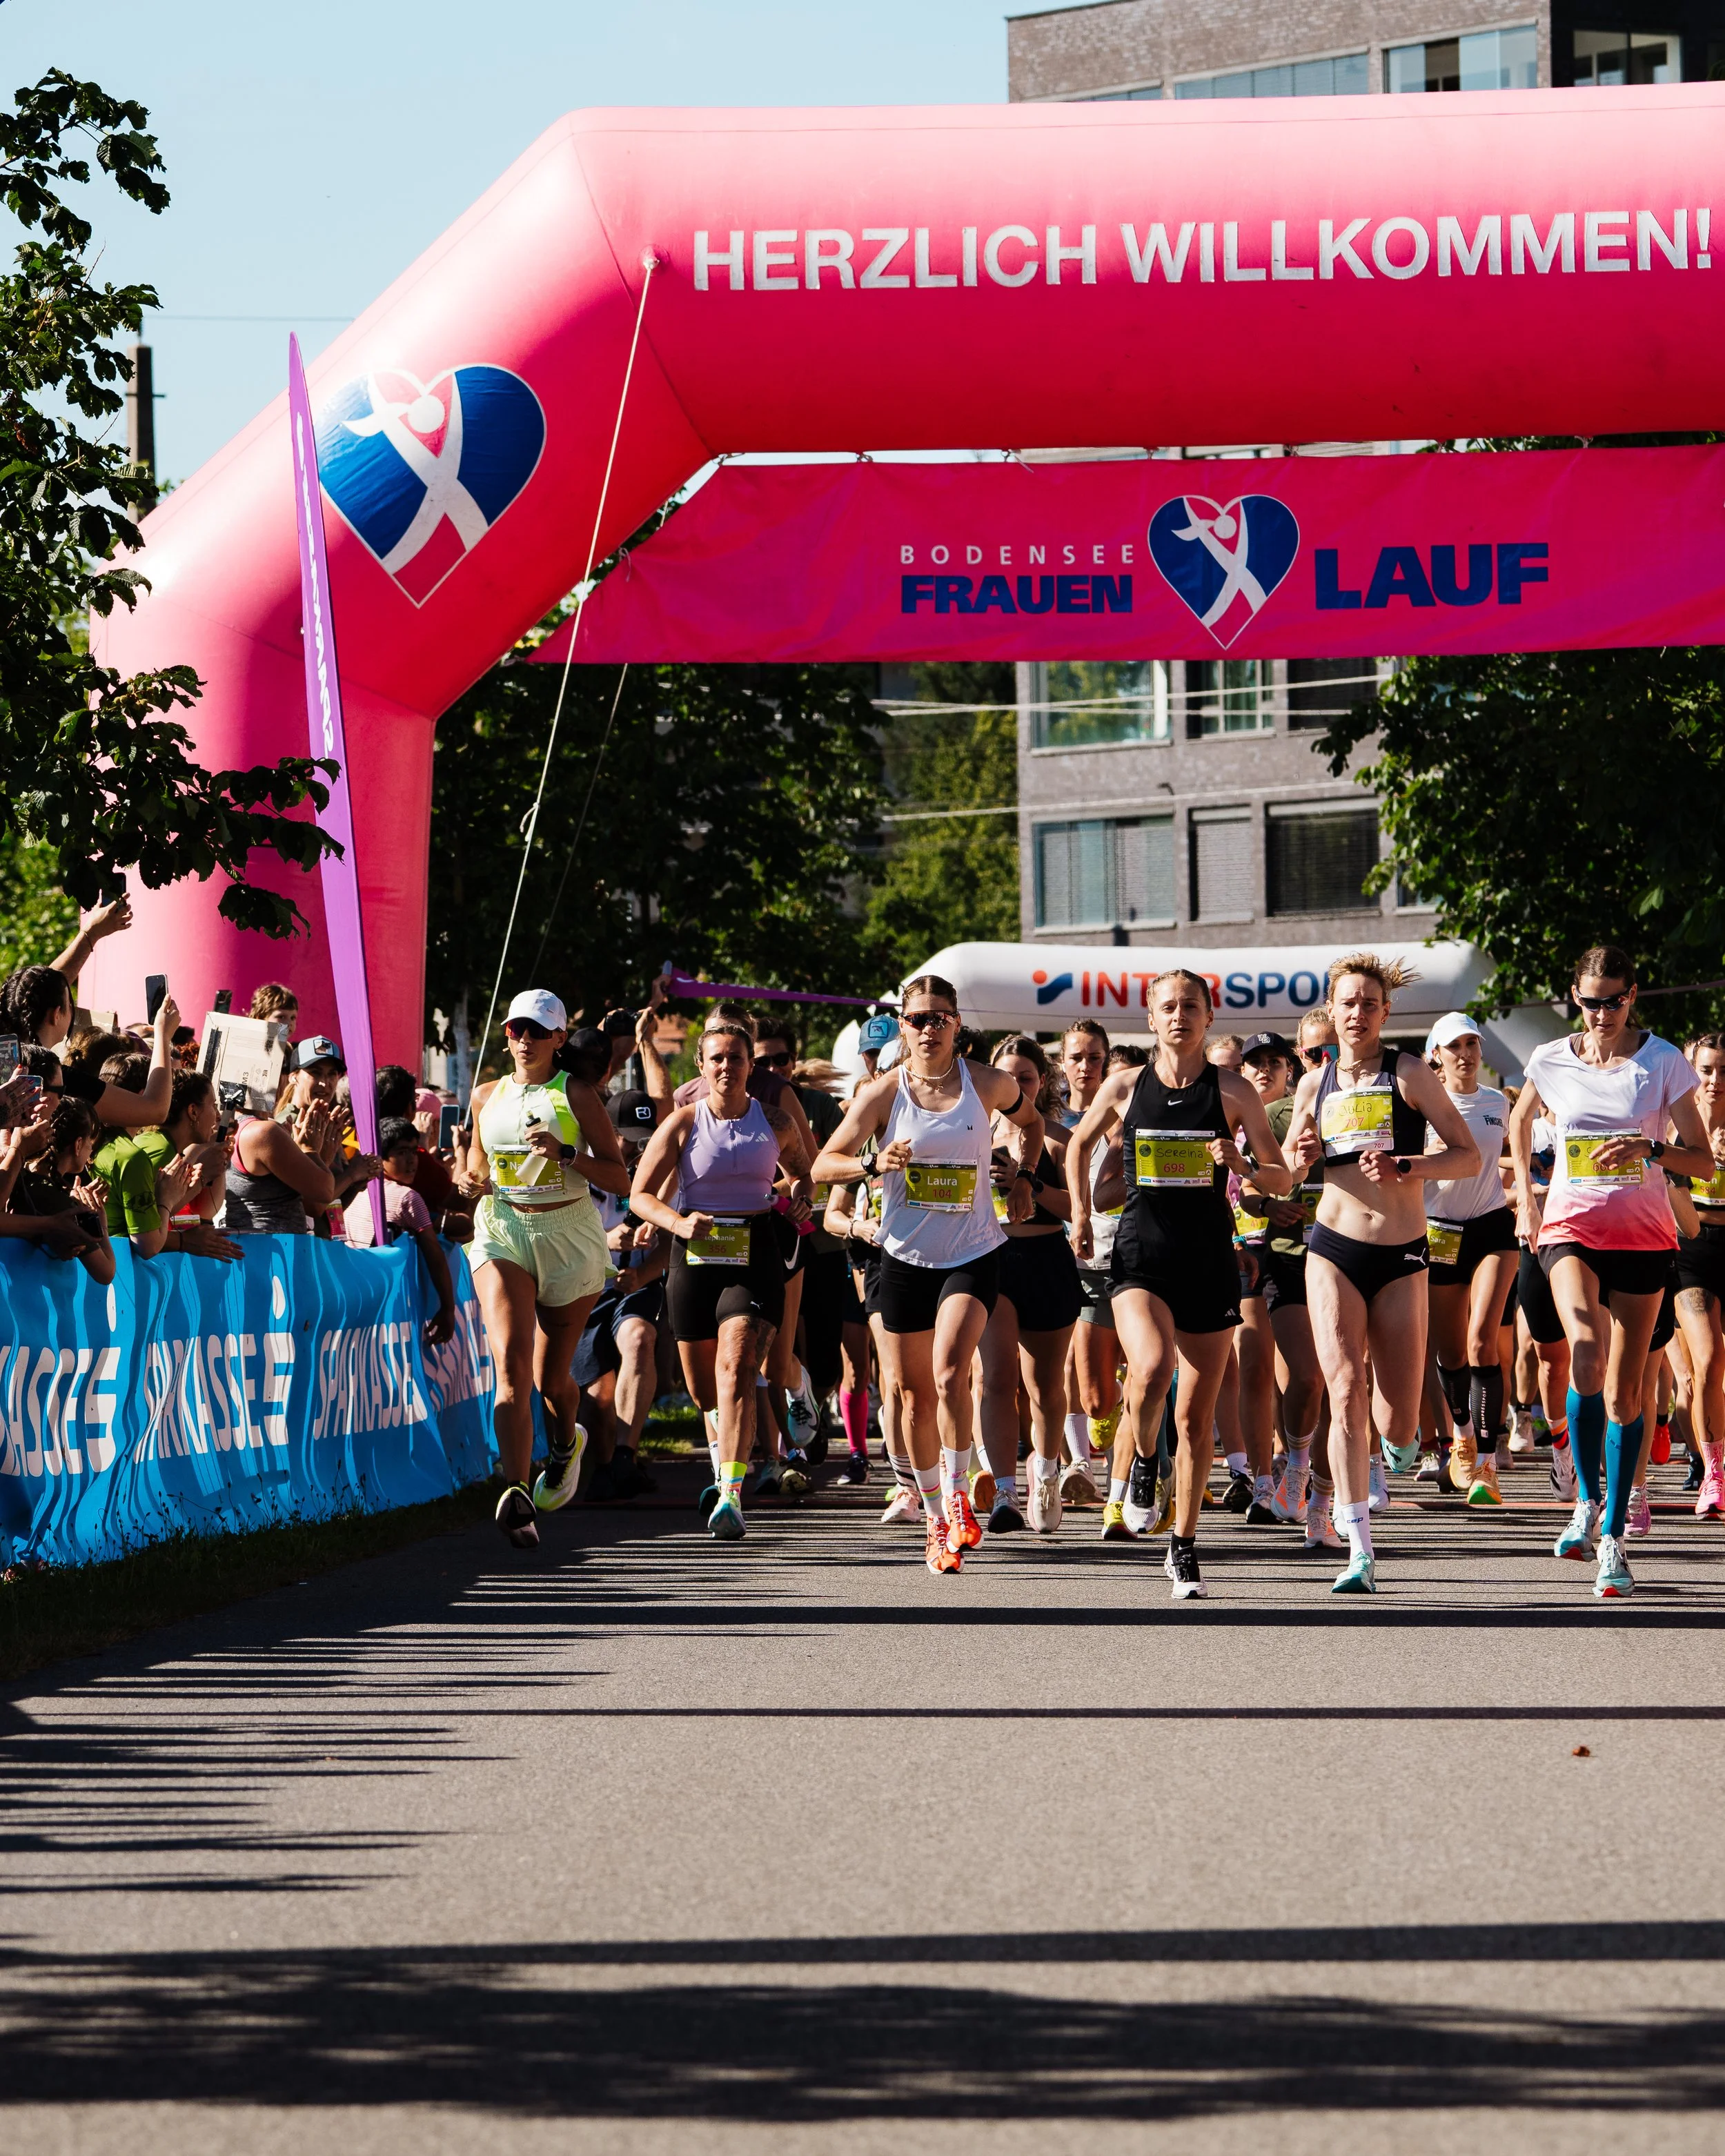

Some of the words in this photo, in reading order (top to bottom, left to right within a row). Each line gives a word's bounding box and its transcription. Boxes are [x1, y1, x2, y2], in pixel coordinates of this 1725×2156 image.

[694, 225, 1097, 291] HERZLICH
[1119, 208, 1711, 283] WILLKOMMEN!
[900, 544, 1134, 565] BODENSEE
[1314, 542, 1549, 610] LAUF
[901, 574, 1133, 614] FRAUEN
[1081, 971, 1329, 1009] INTRSPO
[1346, 1117, 1364, 1128] 707
[1163, 1163, 1185, 1173] 698
[927, 1176, 958, 1186] Laura
[933, 1189, 952, 1198] 104
[1700, 1186, 1715, 1194] 584
[704, 1234, 736, 1242] tephanie
[1430, 1235, 1446, 1245] Sara
[708, 1244, 727, 1254] 356
[313, 1321, 414, 1441] SPARKASSE
